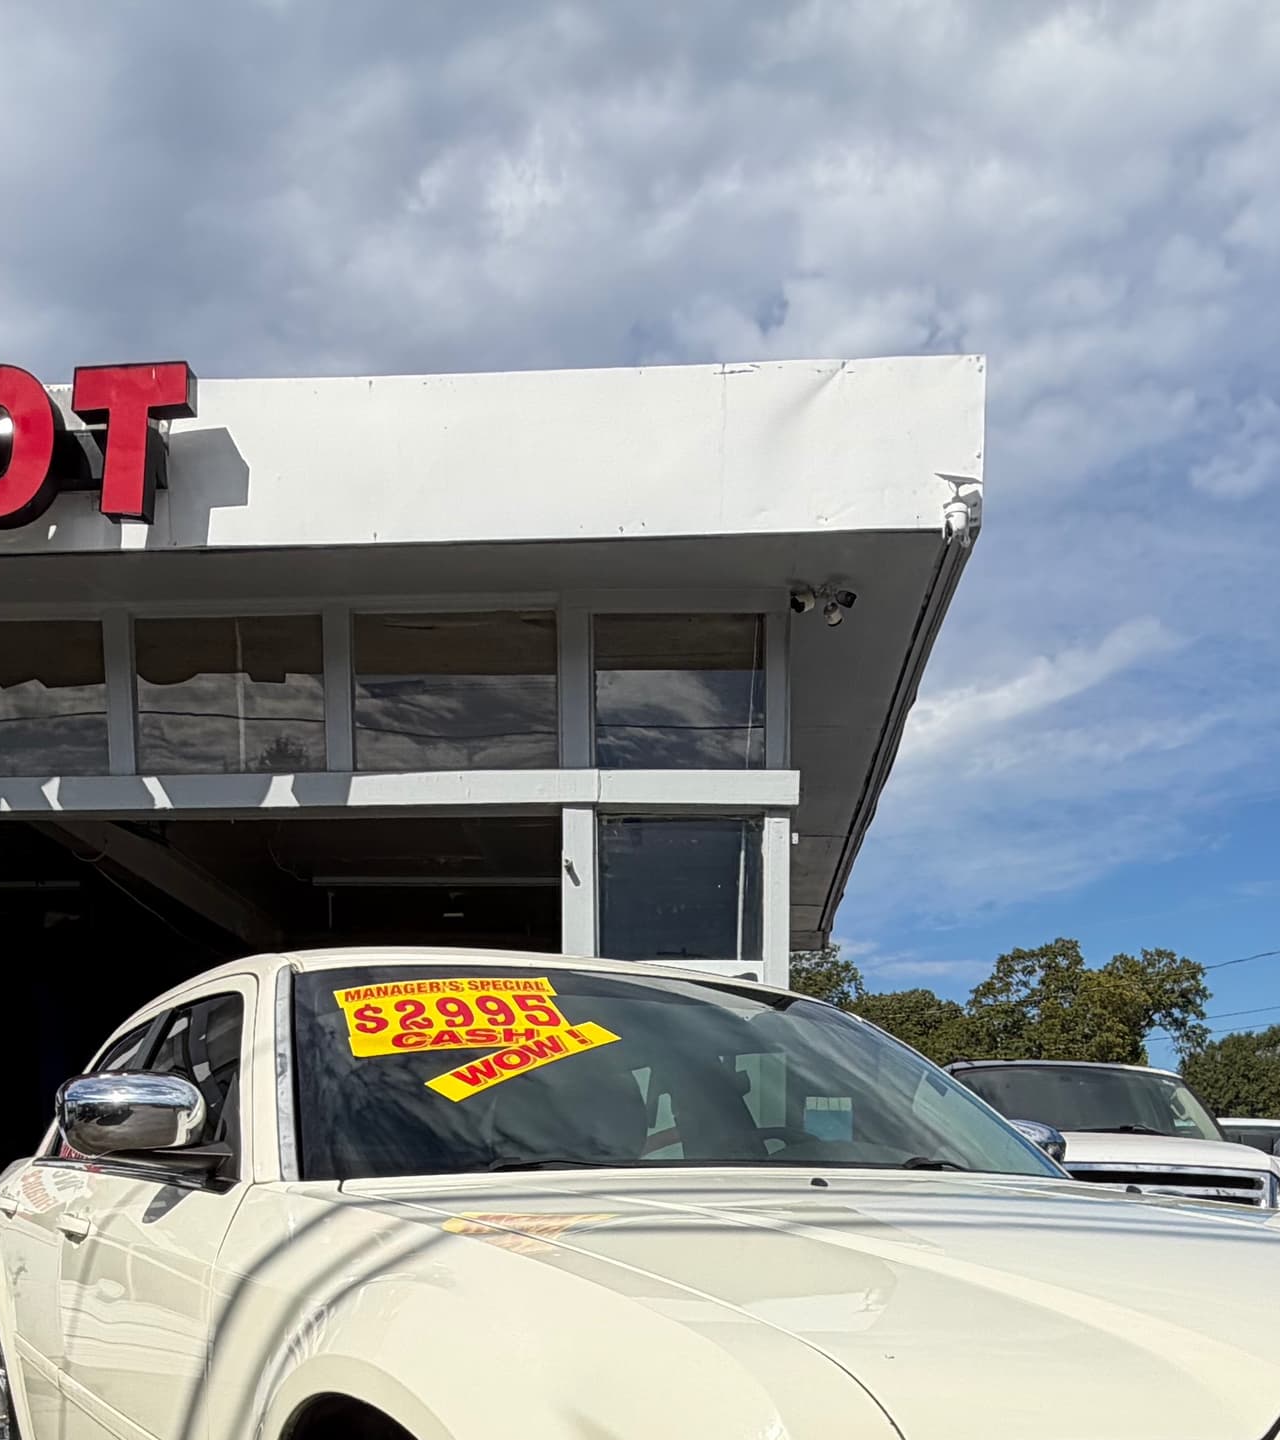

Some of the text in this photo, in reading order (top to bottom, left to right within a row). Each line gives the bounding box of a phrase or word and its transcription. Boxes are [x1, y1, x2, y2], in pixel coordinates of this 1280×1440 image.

[344, 980, 464, 1003] MANAGER'S
[353, 994, 561, 1034] $2995
[391, 1027, 539, 1049] CASH
